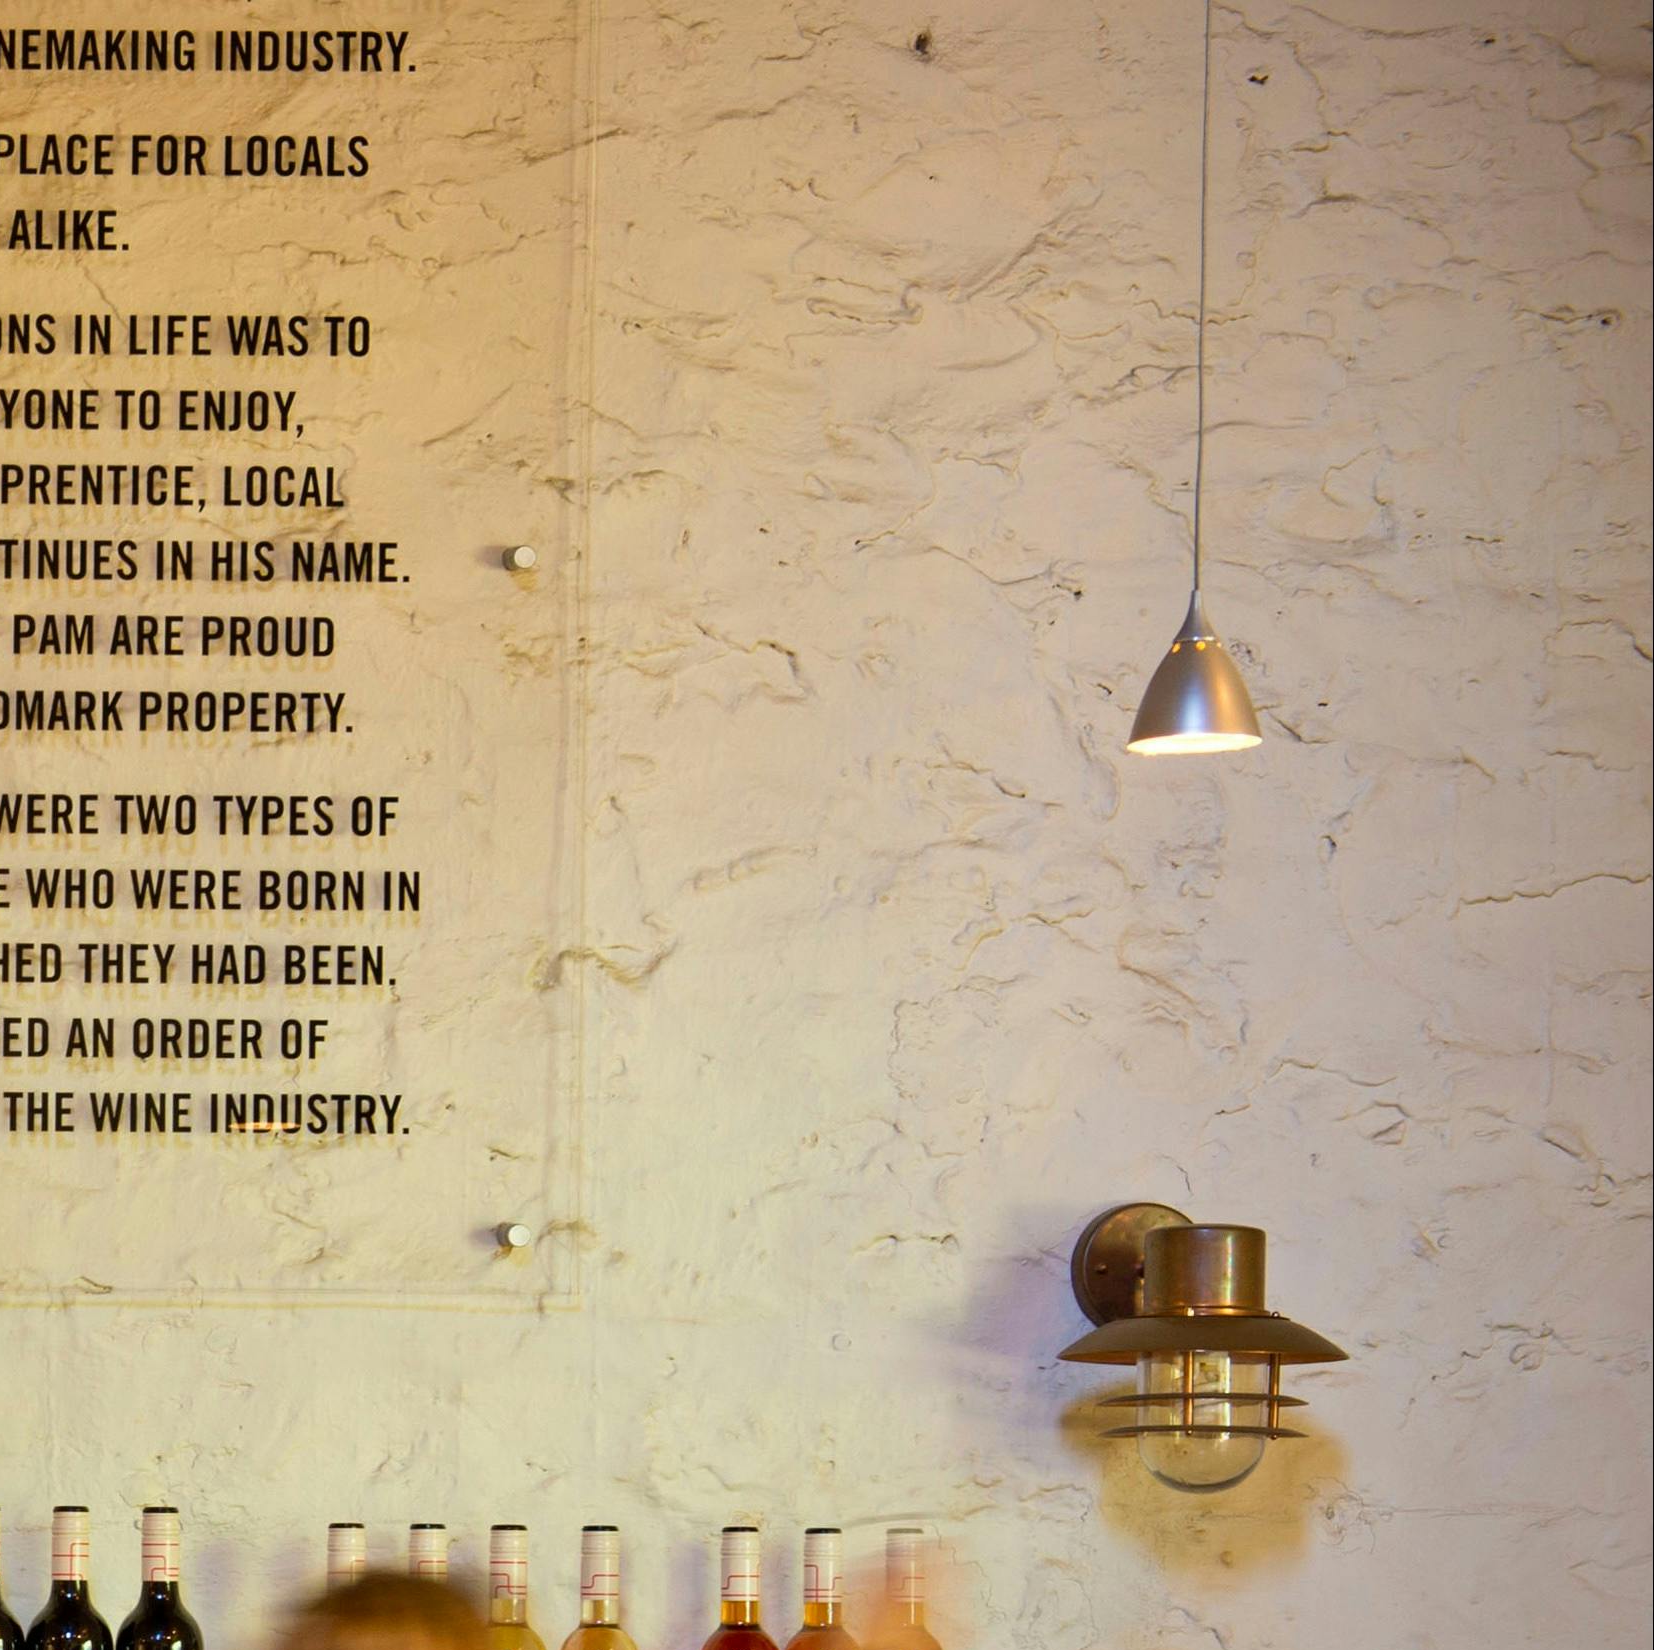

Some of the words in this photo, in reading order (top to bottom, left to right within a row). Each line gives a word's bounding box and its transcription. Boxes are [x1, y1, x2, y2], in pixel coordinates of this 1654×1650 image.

[214, 30, 416, 73] INDUSTRY.
[131, 134, 207, 176] FOR
[224, 135, 369, 178] LOCALS
[8, 209, 129, 251] ALIKE.
[74, 314, 111, 356] IN
[129, 314, 212, 356] LIFE
[226, 315, 309, 357] WAS
[323, 315, 370, 358] TO
[114, 389, 161, 431] TO
[178, 390, 304, 438] ENJOY,
[223, 465, 345, 508] LOCAL
[156, 540, 193, 581] IN
[211, 540, 275, 582] HIS
[291, 541, 410, 583] NAME.
[13, 614, 94, 655] PAM
[109, 615, 184, 656] ARE
[201, 615, 334, 657] PROUD
[139, 691, 353, 734] PROPERTY.
[114, 794, 197, 836] TWO
[212, 795, 334, 837] TYPES
[351, 795, 399, 837] OF
[25, 868, 114, 910] WHO
[130, 869, 242, 910] WERE
[259, 870, 364, 911] BORN
[383, 871, 420, 912] IN
[78, 943, 175, 984] THEY
[191, 944, 266, 985] HAD
[284, 944, 396, 986] BEEN.
[65, 1018, 114, 1058] AN
[132, 1017, 262, 1060] ORDER
[280, 1019, 328, 1060] OF
[3, 1091, 75, 1132] THE
[89, 1092, 192, 1133] WINE
[210, 1093, 410, 1135] INDUSTRY.
